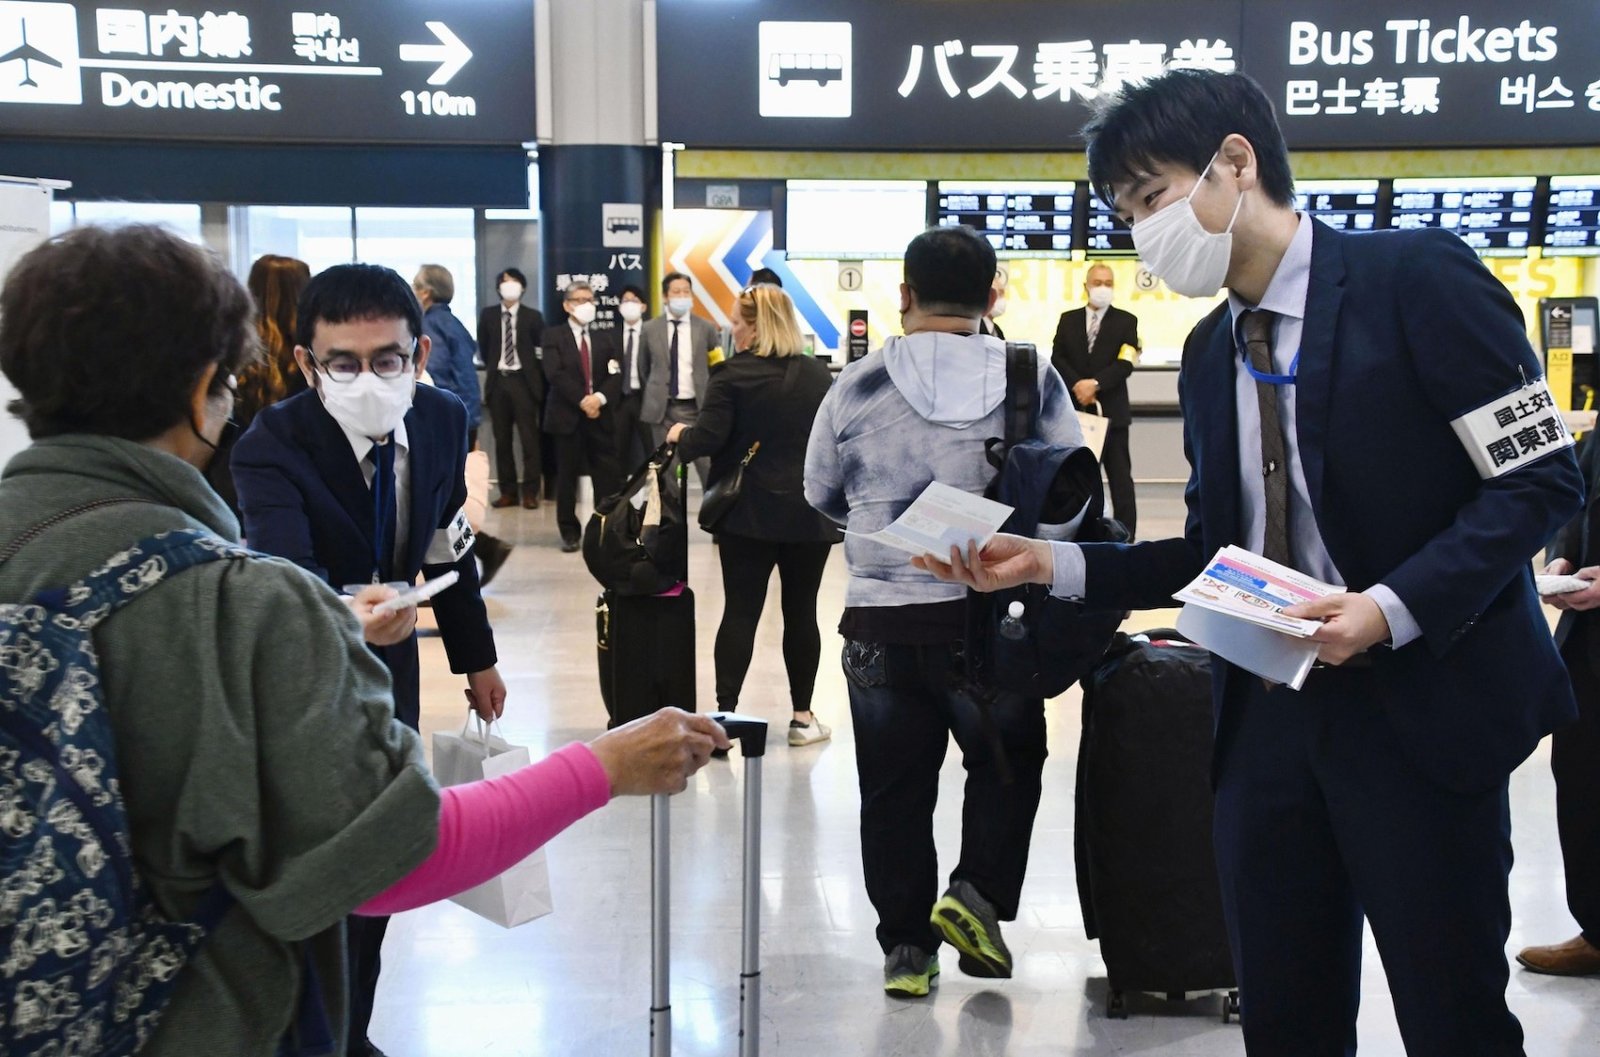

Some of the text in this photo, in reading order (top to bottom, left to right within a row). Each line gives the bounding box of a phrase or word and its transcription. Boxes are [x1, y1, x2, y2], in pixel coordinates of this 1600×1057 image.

[1288, 14, 1559, 65] Bus Tickets
[100, 71, 282, 111] Domestic
[400, 89, 477, 116] 110m
[1285, 76, 1441, 116] 巴士车票
[1499, 73, 1575, 114] 버스
[608, 253, 643, 271] バス
[1485, 414, 1565, 469] 関東運
